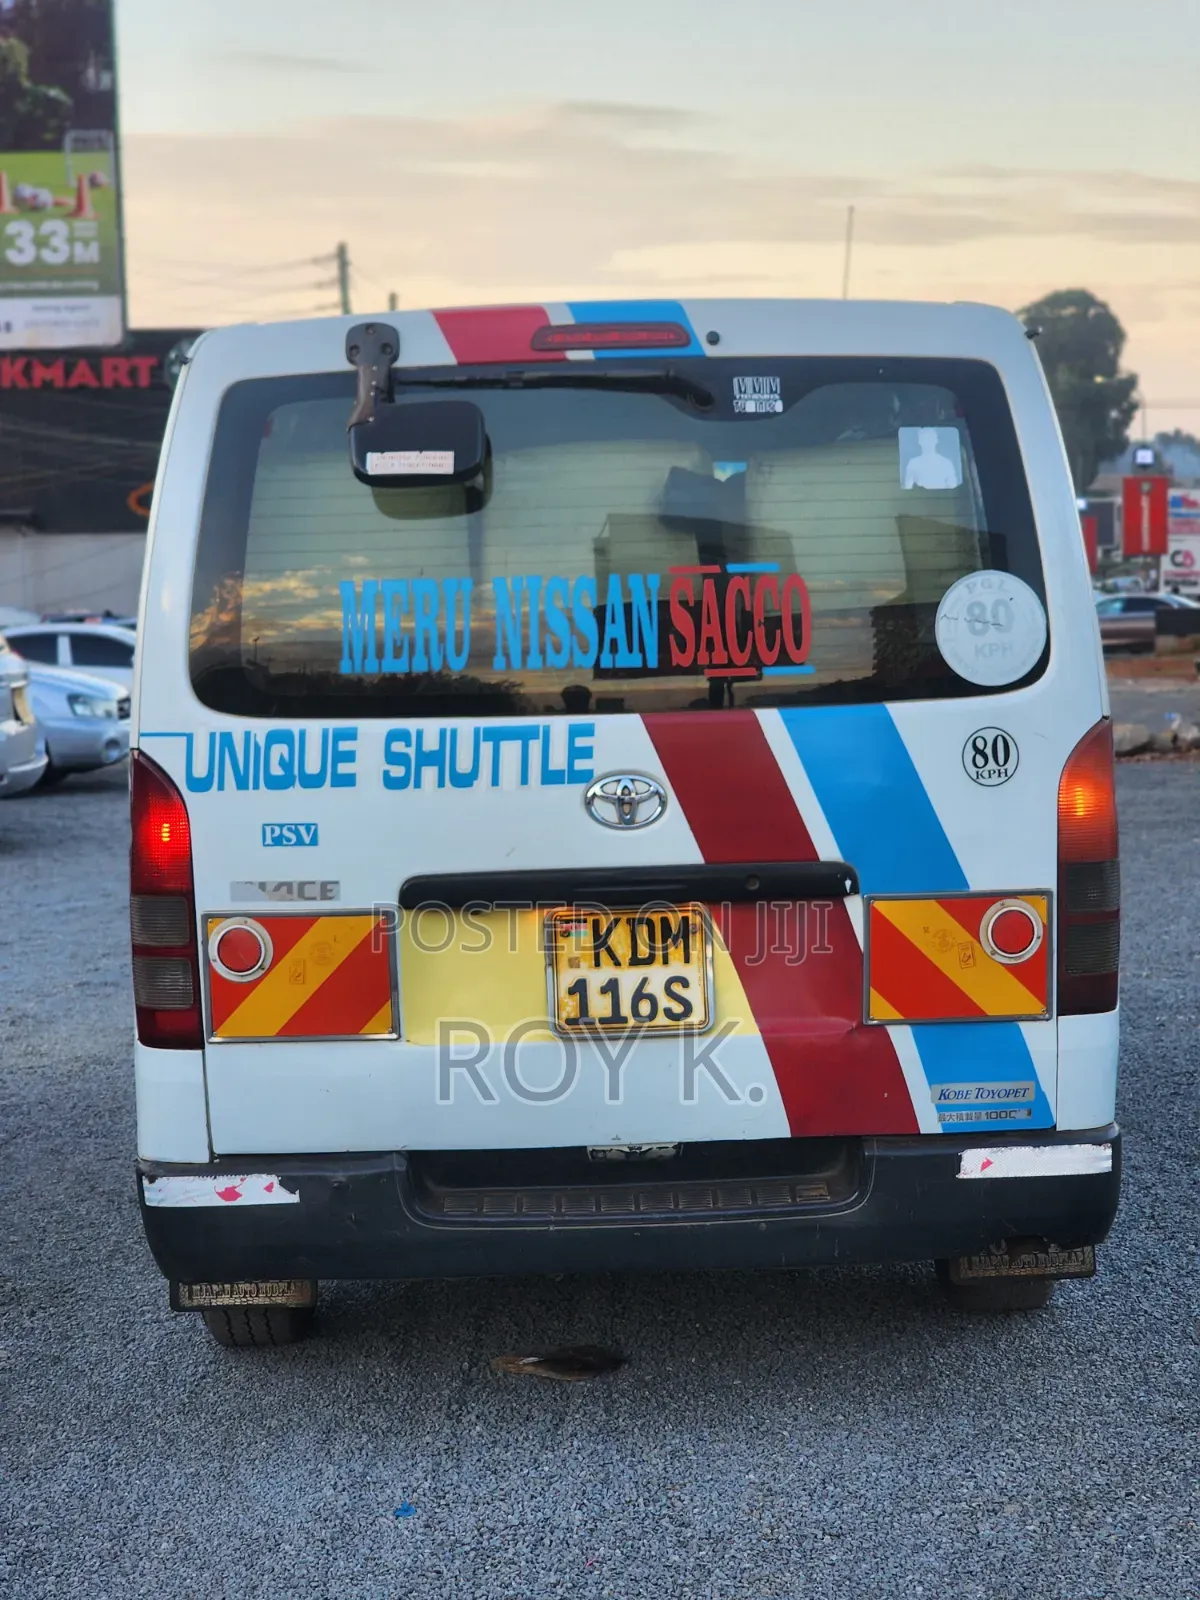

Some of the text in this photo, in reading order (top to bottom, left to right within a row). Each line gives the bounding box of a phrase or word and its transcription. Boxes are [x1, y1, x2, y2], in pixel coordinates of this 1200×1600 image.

[339, 573, 812, 674] MERU NISSAN SACCO
[966, 598, 1014, 636] 80
[974, 642, 1014, 659] KPH
[185, 722, 596, 793] UNIQUE SHUTTLE
[972, 734, 1010, 769] 80
[975, 768, 1008, 780] KPH
[263, 824, 316, 845] PSV
[591, 916, 691, 968] KDM
[564, 976, 694, 1026] 116S
[938, 1087, 1029, 1100] KOBE TOYOPET
